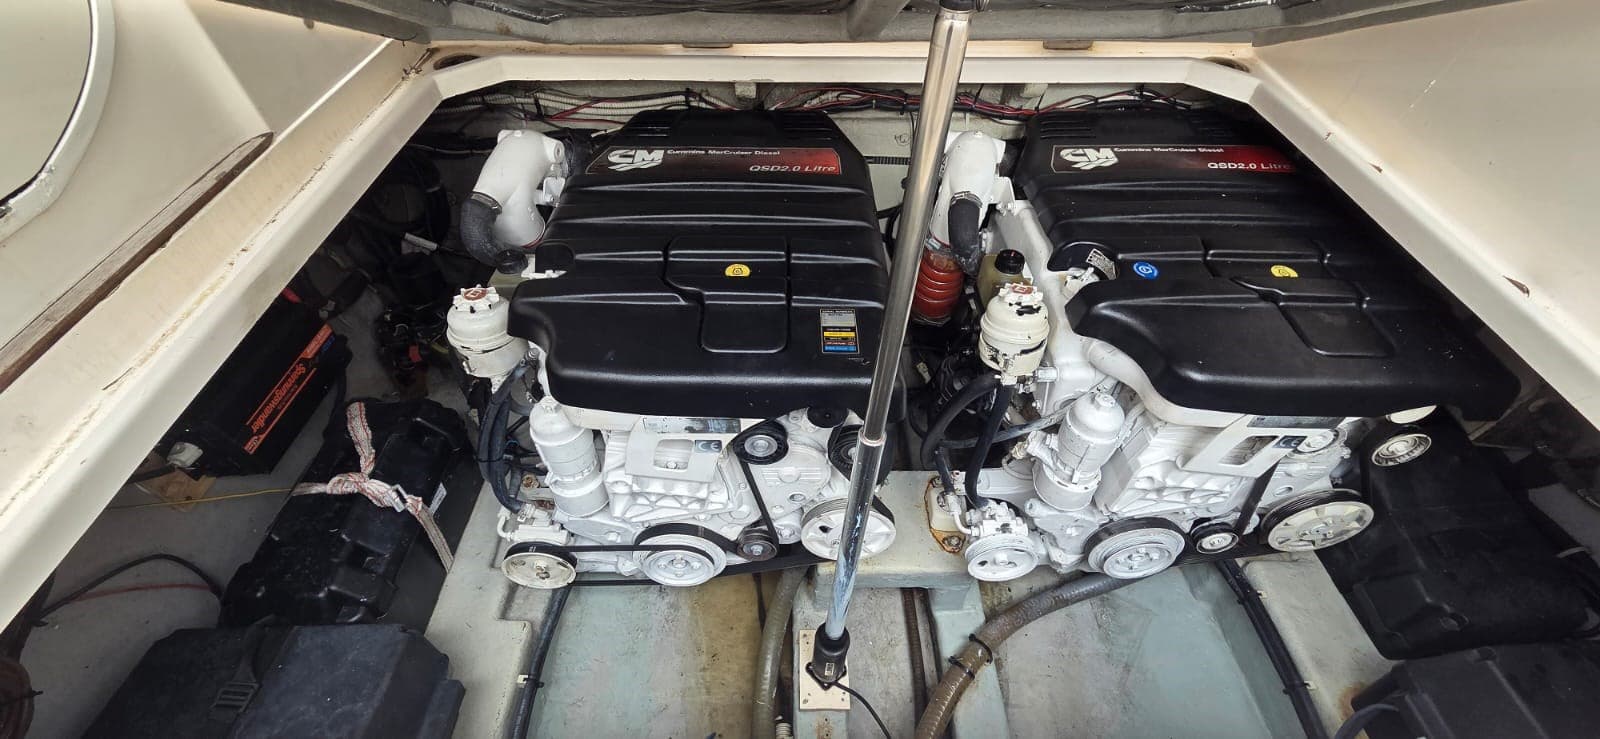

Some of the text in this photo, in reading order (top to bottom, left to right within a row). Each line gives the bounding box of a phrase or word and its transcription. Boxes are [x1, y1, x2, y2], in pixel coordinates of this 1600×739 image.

[608, 149, 665, 167] CM
[1207, 162, 1257, 170] QSD2.0
[698, 440, 721, 452] CE
